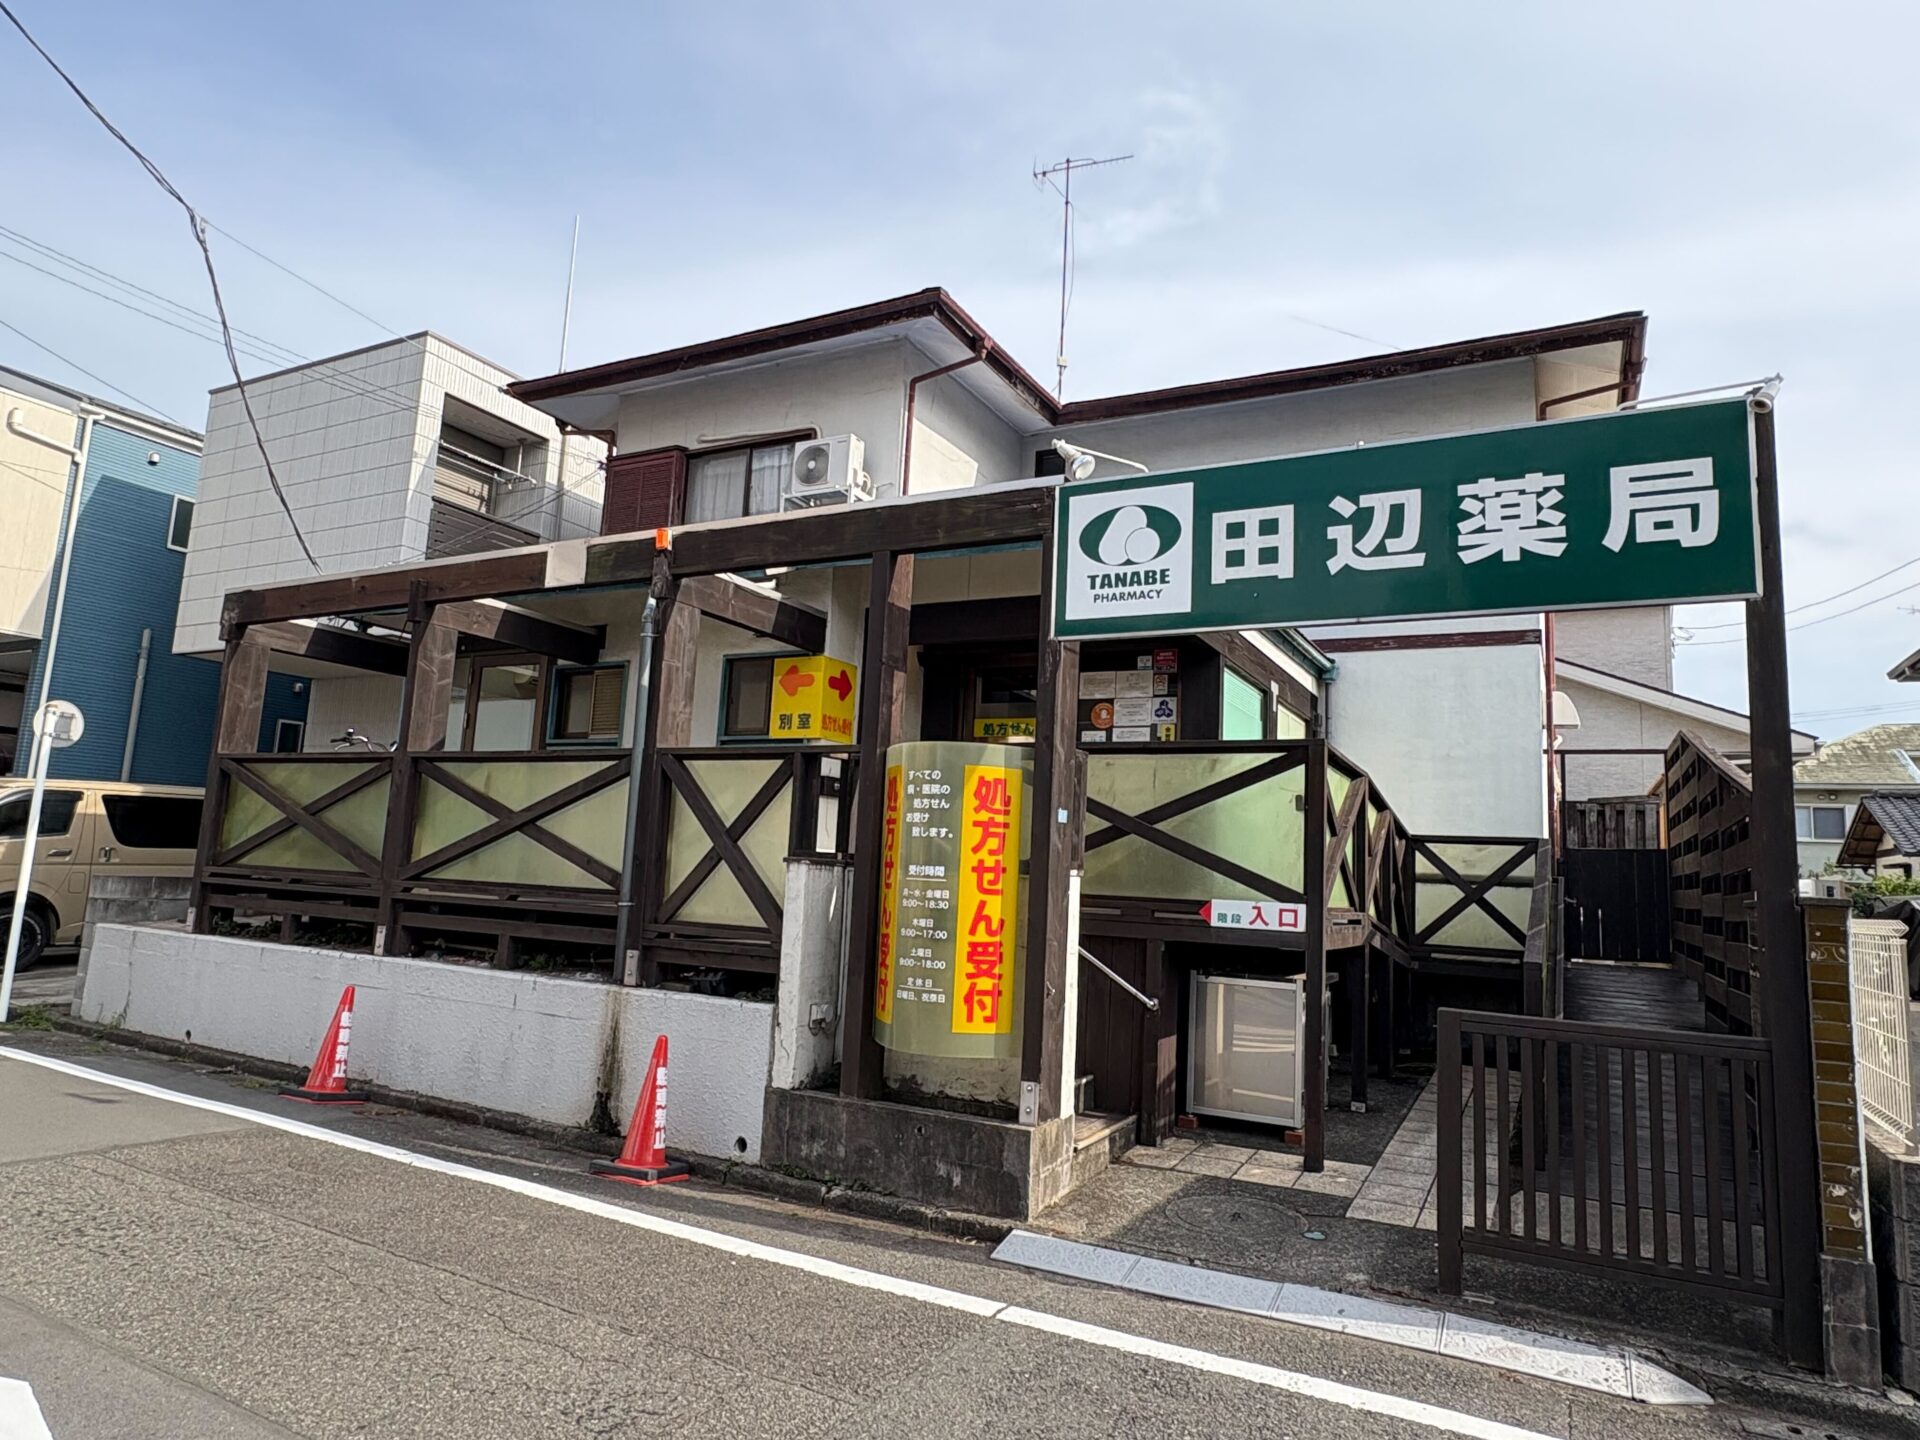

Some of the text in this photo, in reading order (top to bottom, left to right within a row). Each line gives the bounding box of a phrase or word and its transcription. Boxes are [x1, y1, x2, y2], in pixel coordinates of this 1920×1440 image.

[1211, 456, 1720, 585] 田辺薬局
[1087, 568, 1170, 590] TANABE
[1093, 589, 1163, 604] PHARMACY
[779, 713, 811, 730] 別室
[908, 770, 941, 780] すべての
[913, 799, 950, 809] 処方せん
[906, 812, 930, 823] お受け
[912, 827, 953, 838] 致します。
[908, 864, 945, 877] 受付時間
[876, 774, 899, 1013] 処方せん受付
[963, 775, 1011, 1024] 処方せん受付
[912, 918, 934, 927] 木曜日
[1217, 905, 1298, 928] 階段 入口
[910, 947, 932, 957] 土曜日
[907, 977, 933, 988] 定休日
